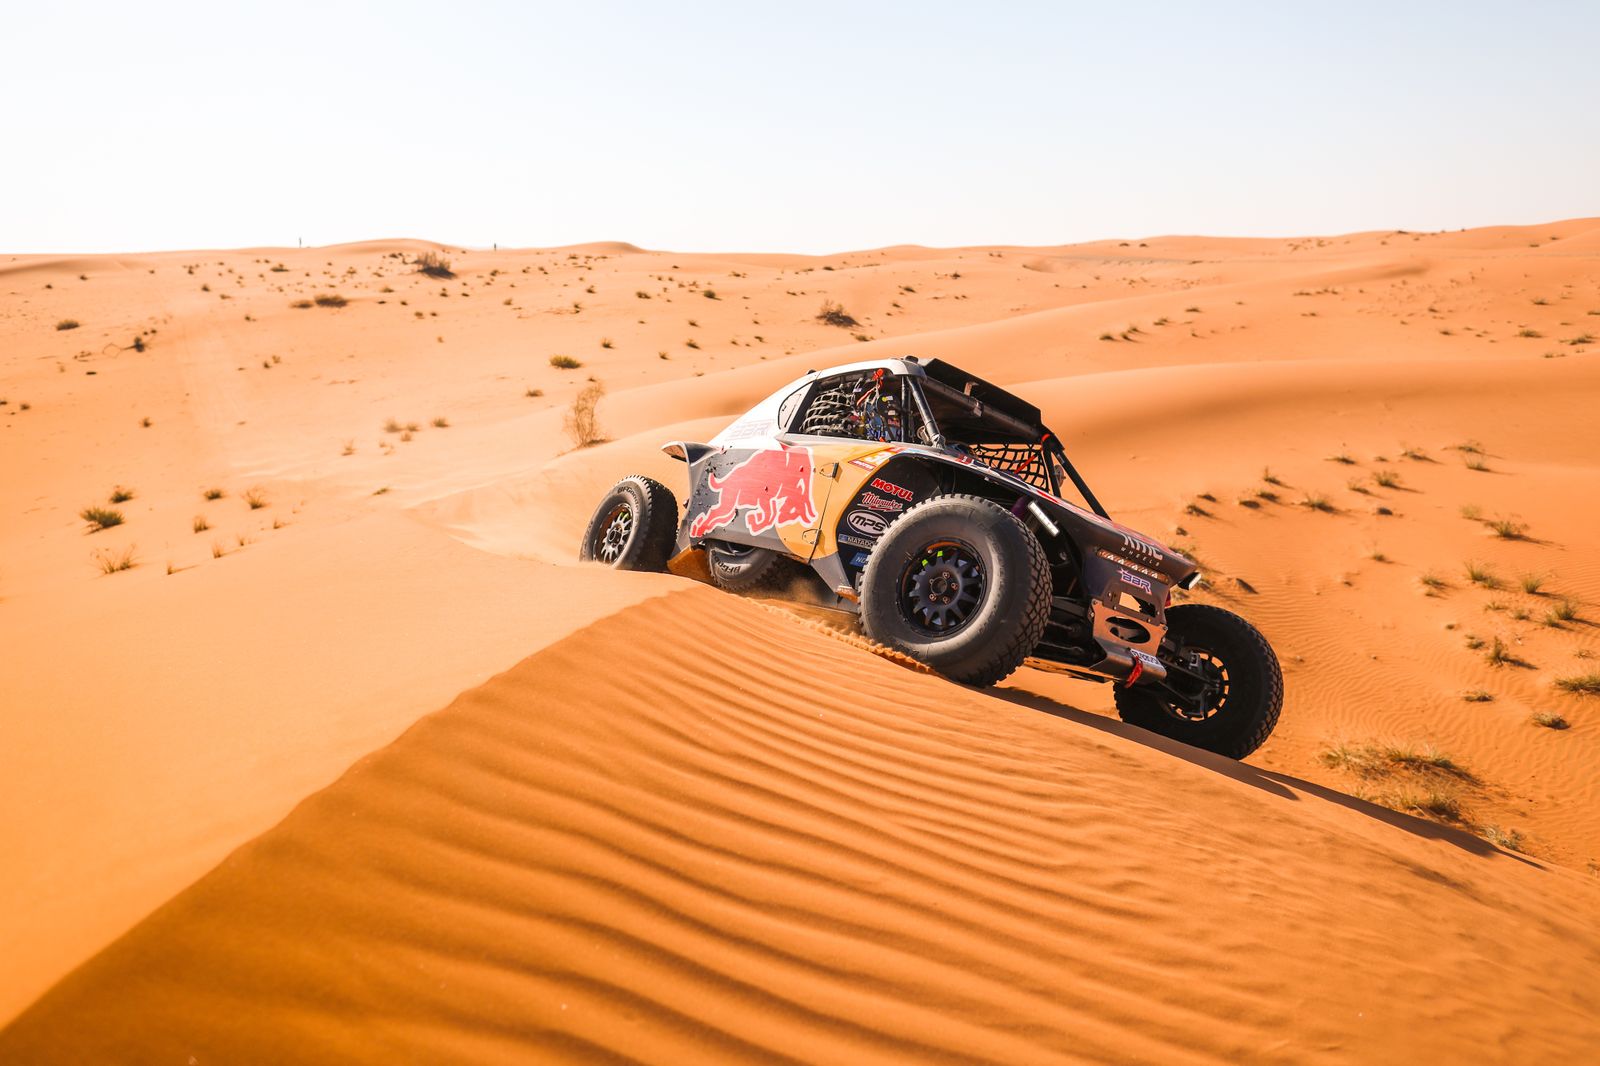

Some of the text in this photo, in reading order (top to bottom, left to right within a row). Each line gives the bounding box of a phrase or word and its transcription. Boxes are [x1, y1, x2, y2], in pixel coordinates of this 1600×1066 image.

[871, 478, 914, 502] MOTUL
[860, 491, 904, 511] Milwaukee
[851, 515, 886, 531] MPS
[1121, 546, 1160, 567] WHEELS
[1117, 569, 1153, 596] BBR
